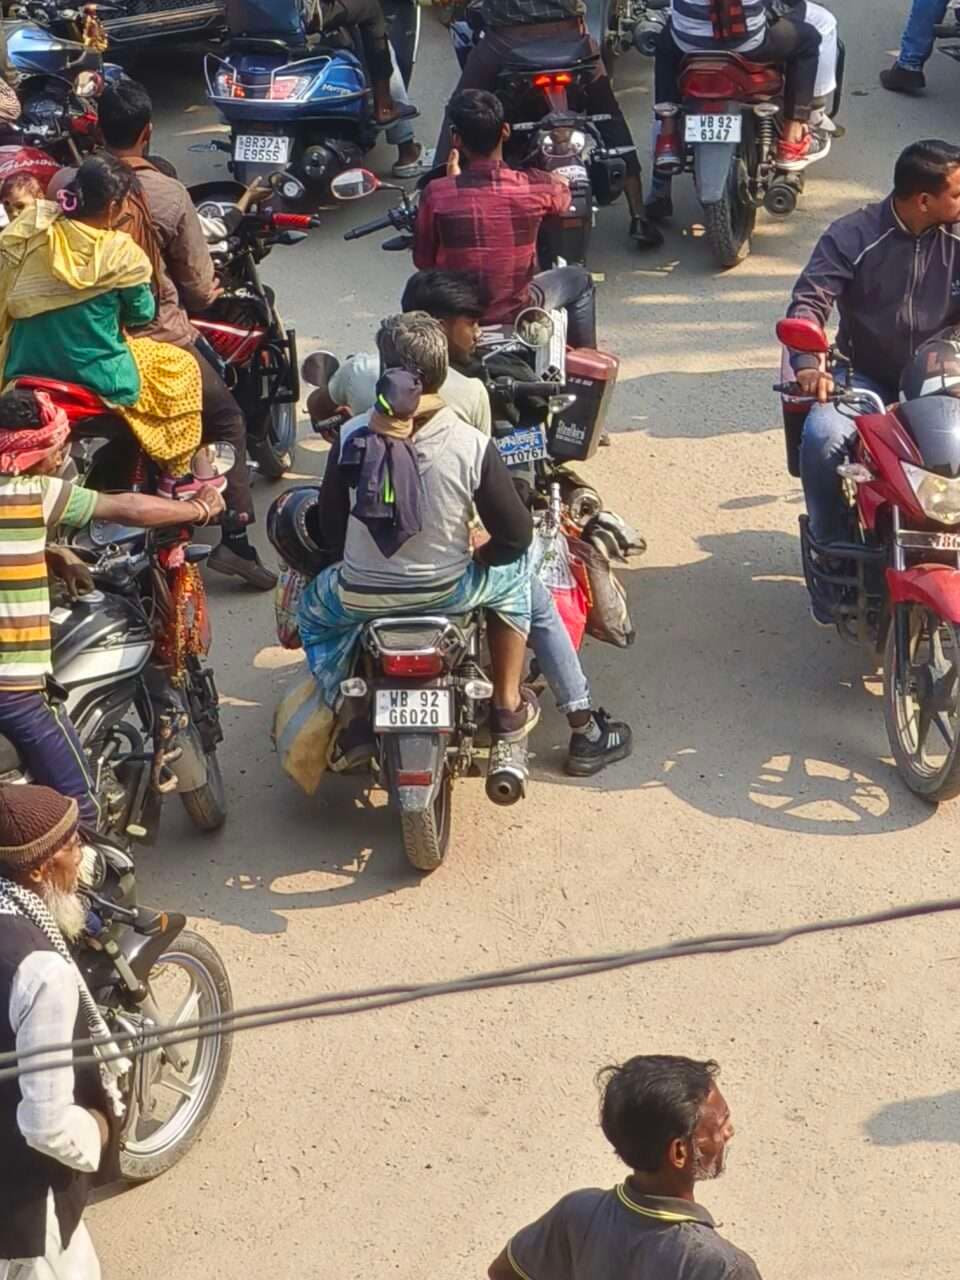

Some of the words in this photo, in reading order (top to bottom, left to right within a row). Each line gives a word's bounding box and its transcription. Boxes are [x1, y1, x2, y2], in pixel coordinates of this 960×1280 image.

[700, 116, 714, 128] WB
[718, 116, 732, 129] 92
[700, 128, 730, 141] 6347
[244, 136, 281, 150] BR37A
[243, 148, 280, 161] E9555
[390, 691, 409, 708] WB
[420, 691, 440, 708] 92
[389, 708, 440, 725] G6020
